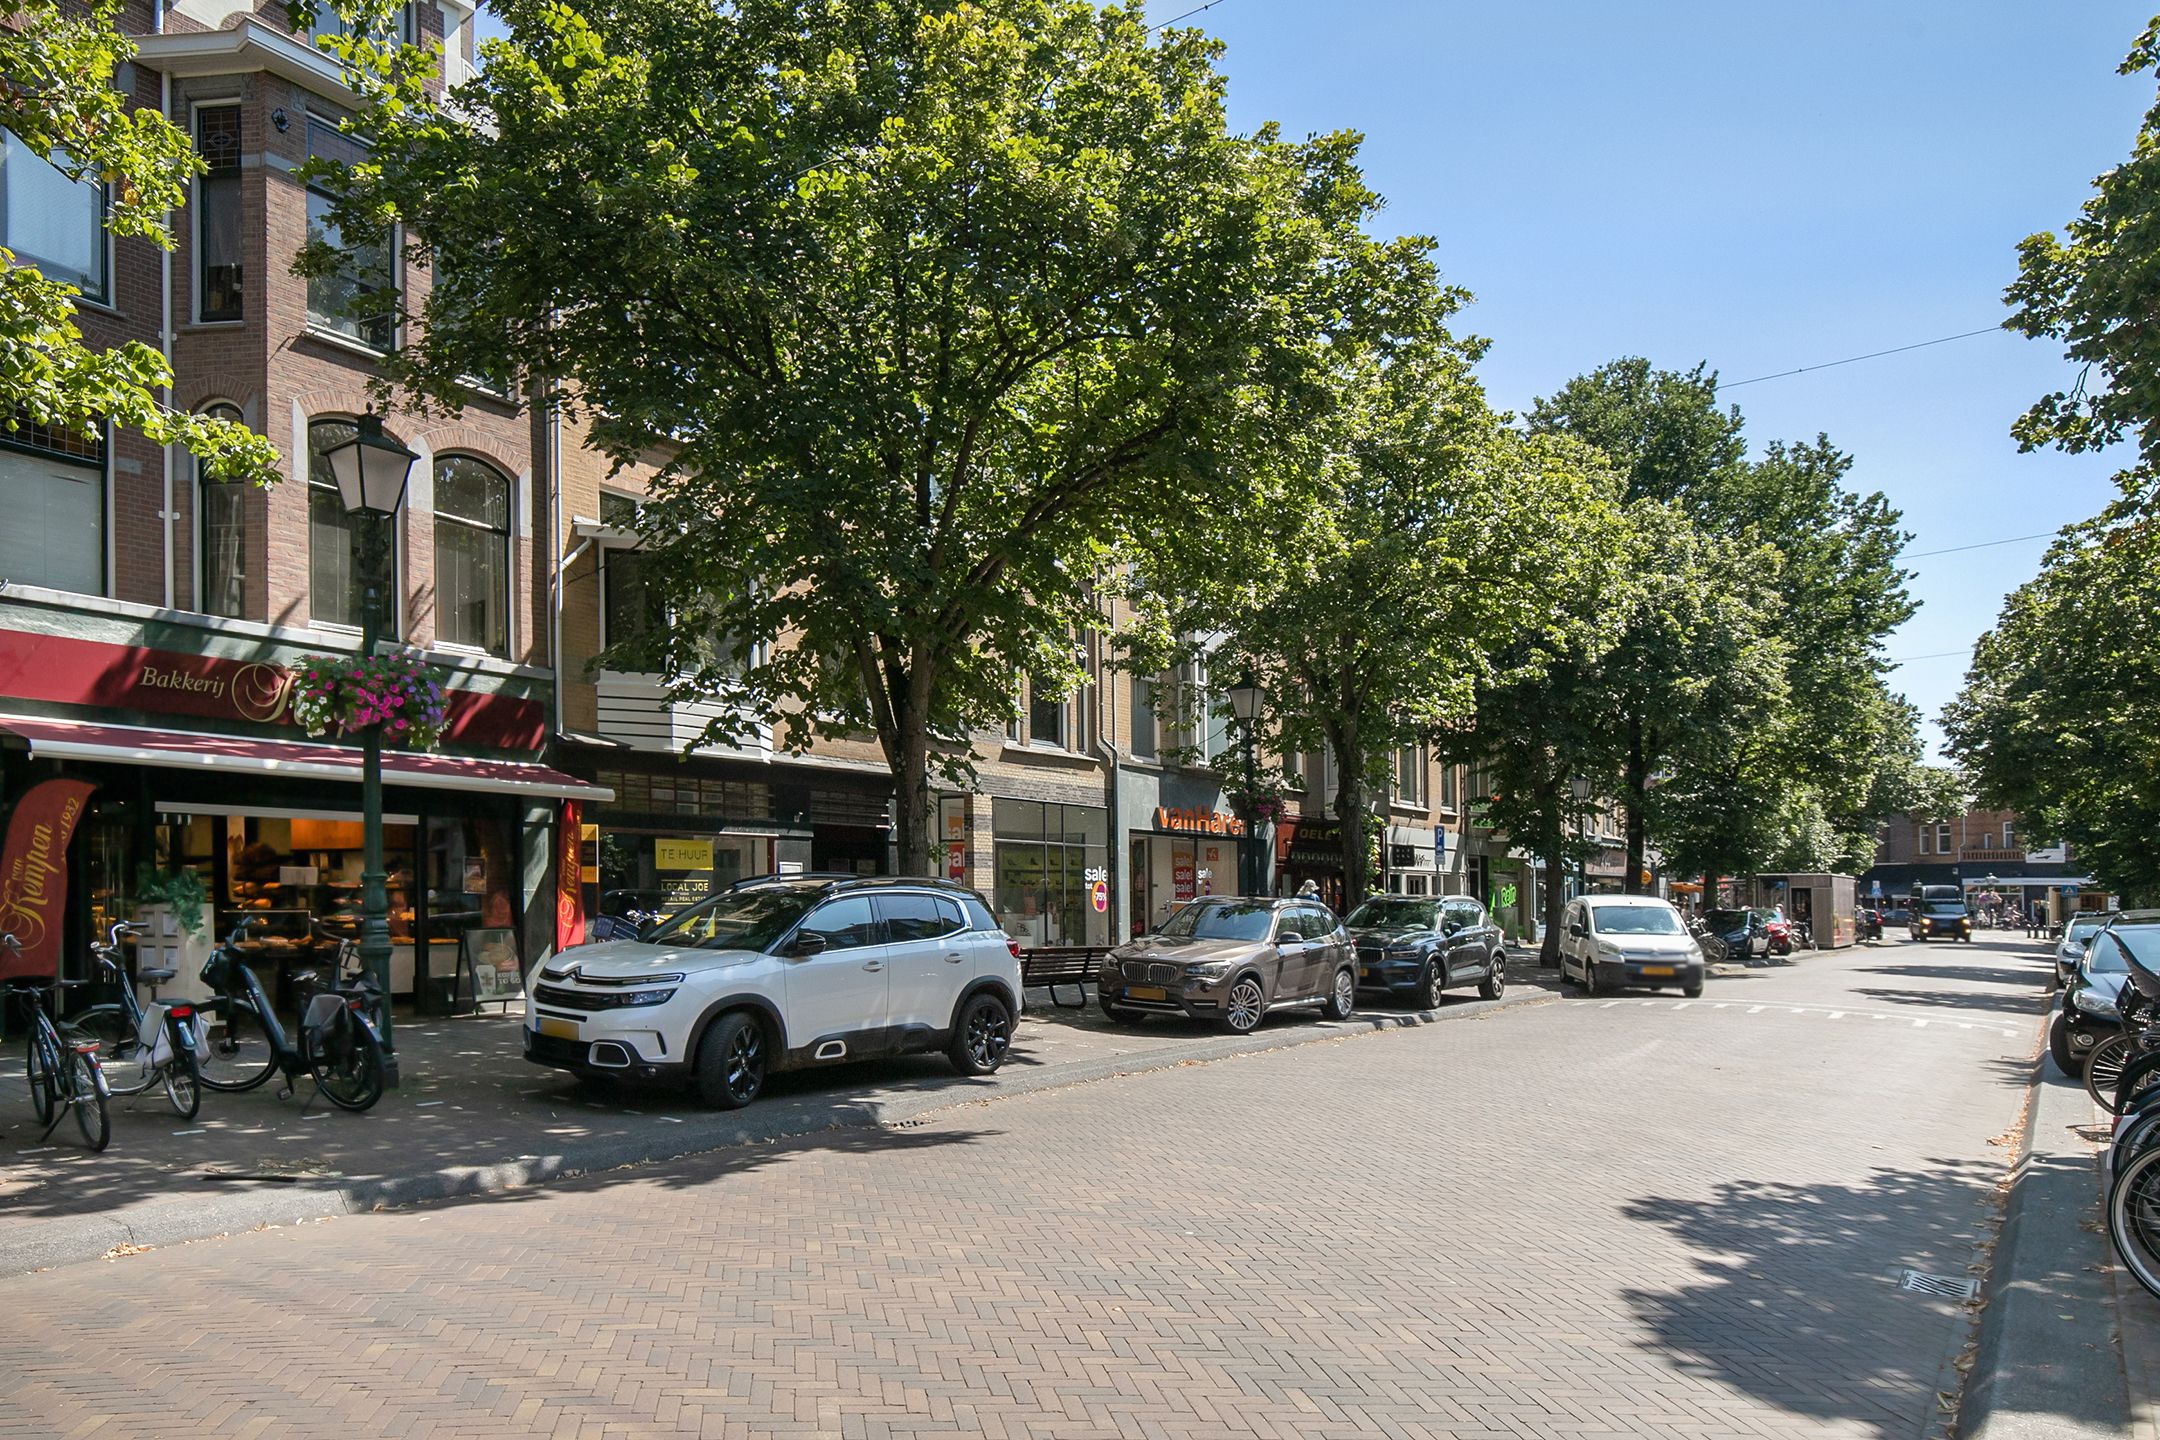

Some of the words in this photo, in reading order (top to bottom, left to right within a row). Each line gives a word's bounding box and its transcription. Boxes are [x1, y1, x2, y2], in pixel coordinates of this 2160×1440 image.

[140, 666, 225, 699] Bakkerij
[1437, 828, 1443, 843] P
[661, 848, 675, 860] TE
[1084, 865, 1108, 882] sale
[1175, 869, 1193, 880] sale!
[1197, 867, 1213, 879] sale
[661, 883, 689, 891] LOCAL
[692, 883, 709, 891] JOE
[1175, 882, 1193, 893] sale!
